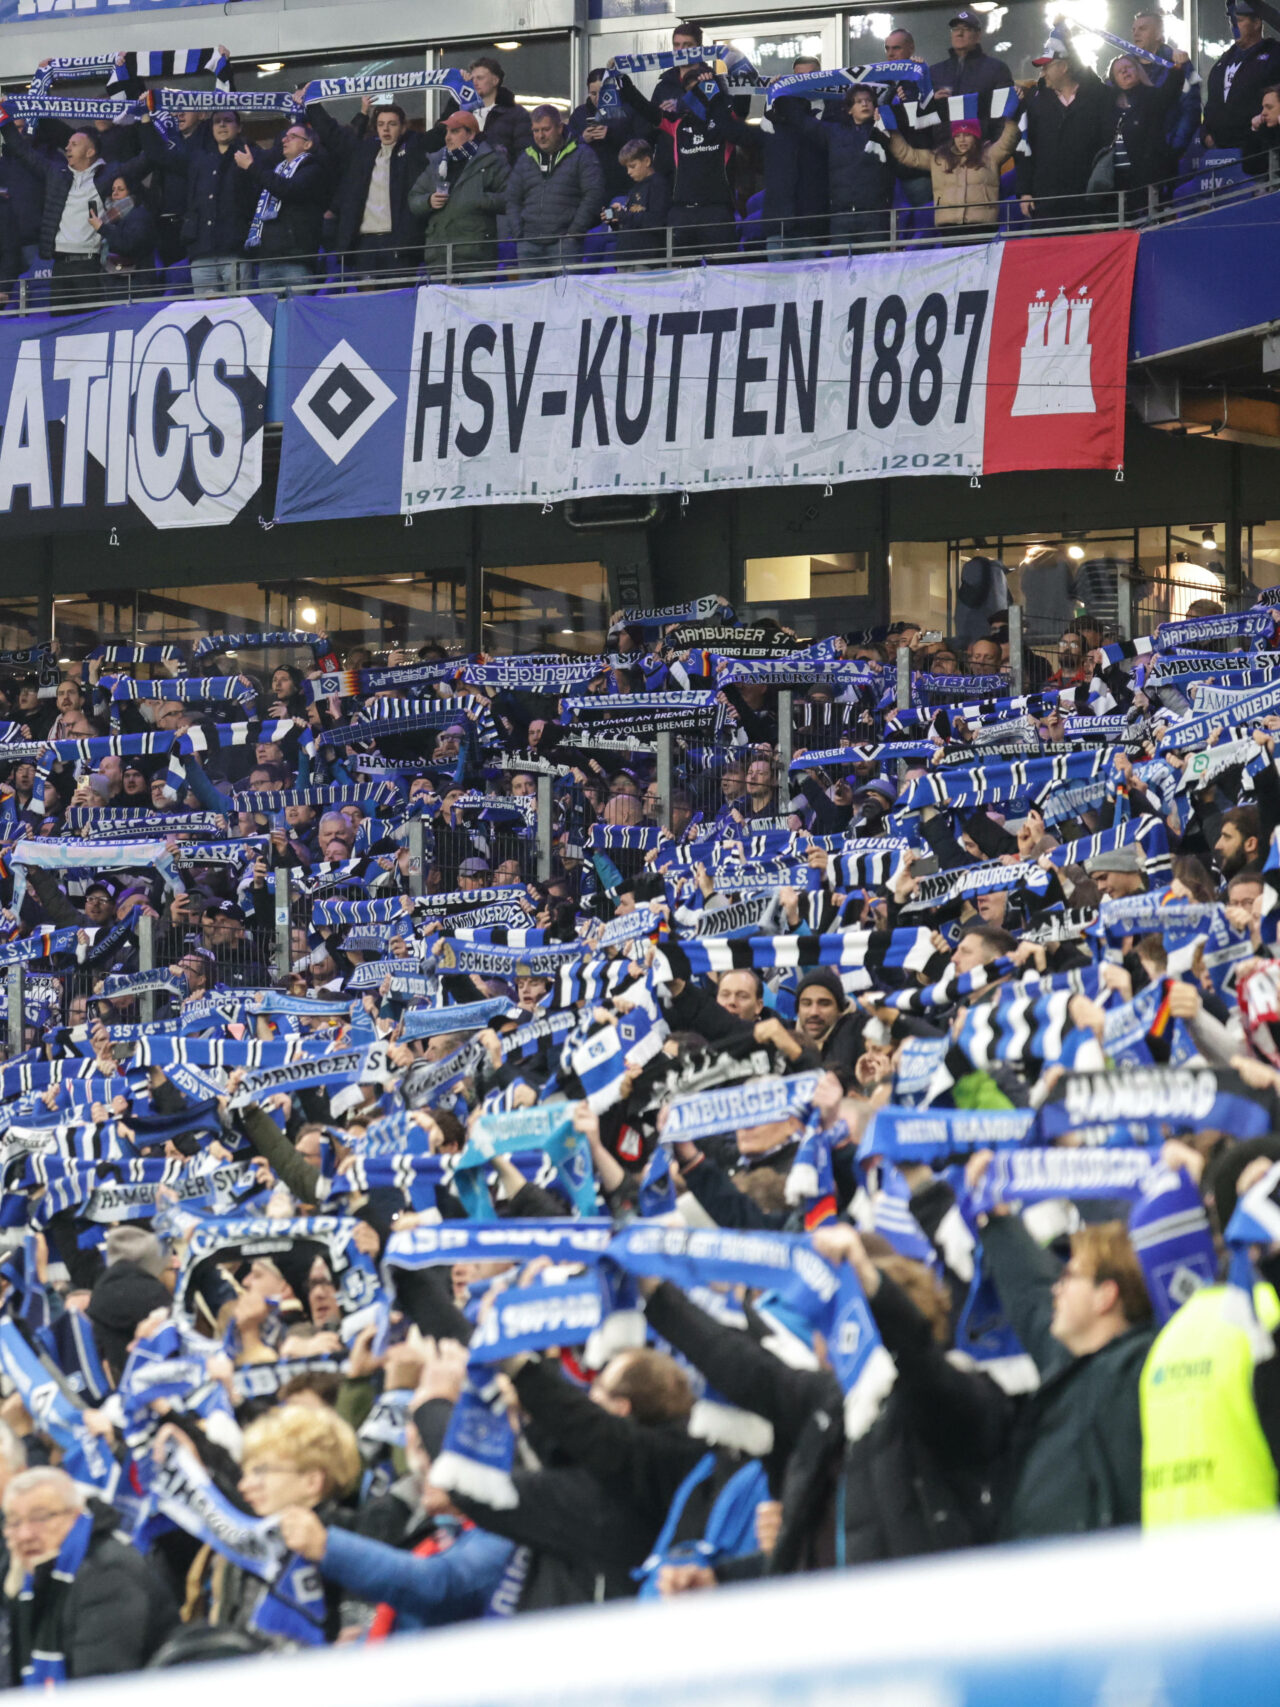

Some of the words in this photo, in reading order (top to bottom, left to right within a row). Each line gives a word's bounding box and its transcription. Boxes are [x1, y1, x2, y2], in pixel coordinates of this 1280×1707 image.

[162, 91, 275, 107] HAMBURGER
[1205, 158, 1236, 166] RECARO
[1200, 178, 1222, 190] HSV
[413, 300, 823, 463] HSV-KUTTEN
[848, 290, 989, 431] 1887
[404, 485, 466, 508] 1972
[891, 452, 966, 470] 2021
[697, 599, 717, 614] SV
[675, 627, 766, 644] HAMBURGER
[1161, 621, 1239, 647] HAMBURGER
[742, 648, 769, 657] LIEB'
[1257, 655, 1280, 669] SV
[593, 718, 626, 727] DUMME
[650, 710, 696, 722] BREMEN
[698, 706, 714, 716] IST,
[656, 720, 695, 730] BREMER
[698, 718, 712, 726] IST
[1174, 723, 1205, 745] HSV
[1209, 716, 1229, 735] IST
[941, 748, 974, 764] MEIN
[977, 744, 1040, 756] HAMBURG
[1044, 743, 1076, 753] LIEB'
[1080, 742, 1103, 753] ICH
[752, 818, 771, 832] NICHT
[421, 907, 447, 917] 1887
[6, 940, 36, 960] S.V.
[458, 950, 514, 973] SCHEISS
[174, 1068, 195, 1091] HSV
